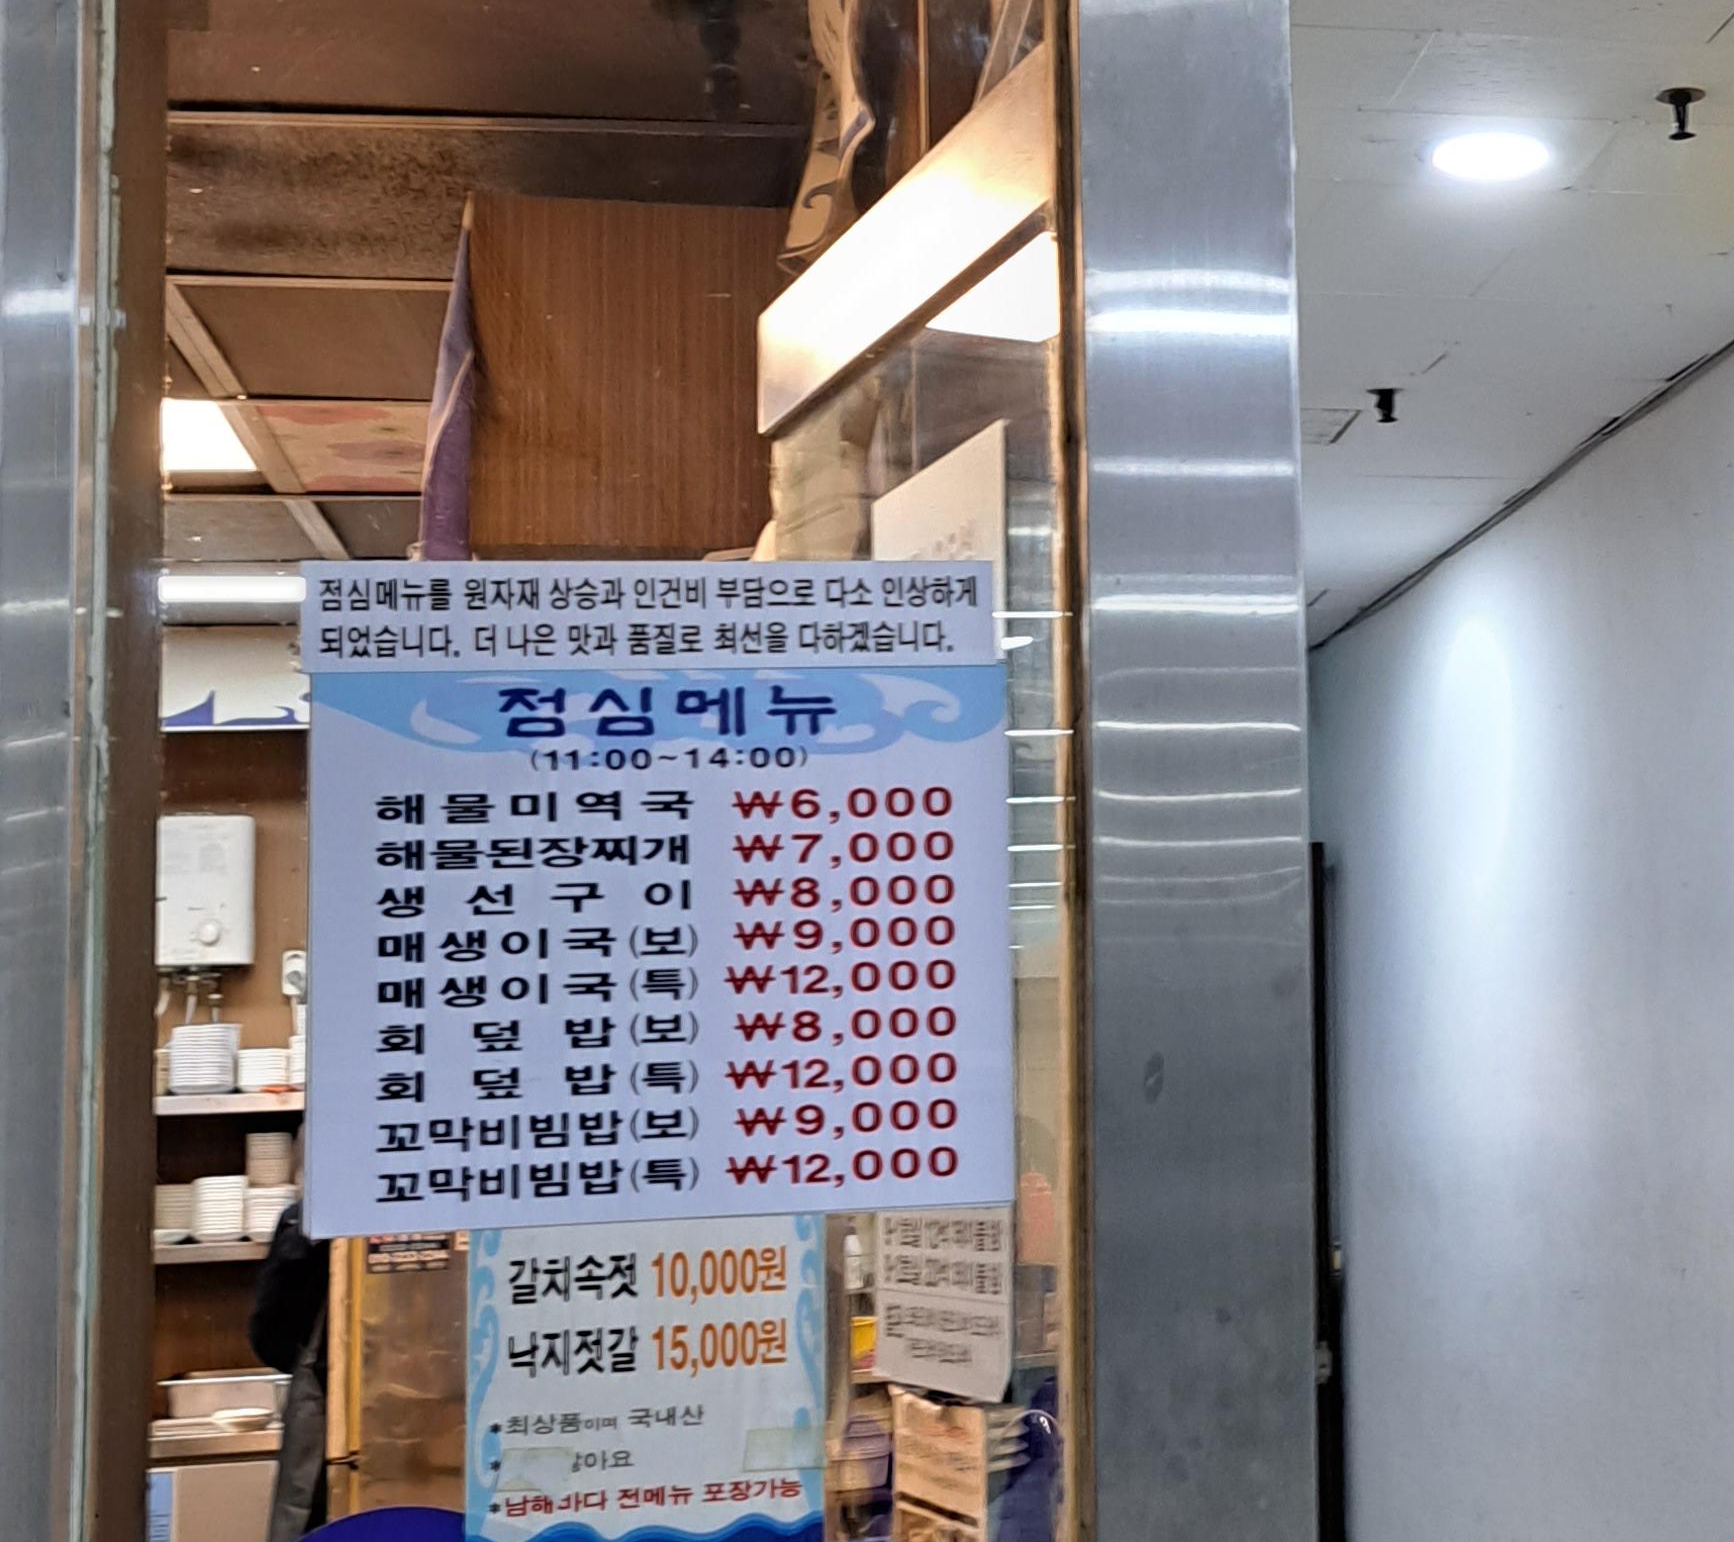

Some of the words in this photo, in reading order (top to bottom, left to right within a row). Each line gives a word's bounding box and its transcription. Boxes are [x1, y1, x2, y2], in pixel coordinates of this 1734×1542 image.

[319, 578, 452, 611] 점심메뉴를
[464, 577, 540, 610] 원자재
[550, 577, 624, 610] 상승과
[633, 577, 706, 609] 인건비
[715, 577, 817, 609] 부담으로
[825, 576, 873, 608] 다소
[882, 575, 977, 607] 인상하게
[320, 624, 460, 659] 되었습니다.
[474, 624, 496, 657] 더
[507, 623, 556, 656] 나은
[568, 623, 617, 656] 맛과
[627, 622, 704, 655] 품질로
[714, 621, 789, 654] 최선을
[799, 620, 954, 653] 다하겠습니다.
[497, 685, 838, 738] 점심메뉴
[529, 745, 809, 772] (11:00~14:00)
[375, 790, 694, 826] 해물미역국
[731, 786, 953, 824] ₩6,000
[375, 834, 690, 872] 해물된장찌개
[732, 830, 955, 870] ₩7,000
[732, 874, 956, 912] ₩8,000
[377, 923, 699, 964] 매생이국(보)
[733, 916, 956, 956] ₩9,000
[377, 966, 699, 1010] 매생이국(특)
[724, 959, 957, 999] ₩12,000
[735, 1007, 957, 1046] ₩8,000
[725, 1052, 958, 1095] ₩12,000
[376, 1106, 699, 1154] 꼬막비빔밥(보)
[734, 1099, 958, 1142] ₩9,000
[376, 1155, 699, 1204] 꼬막비빔밥(특)
[725, 1146, 959, 1190] ₩12,000
[508, 1254, 639, 1306] 갈치속젓
[651, 1245, 787, 1304] 10,000원
[508, 1326, 639, 1379] 낙지젓갈
[651, 1318, 787, 1377] 15,000원
[505, 1412, 618, 1436] 최상품이며
[628, 1404, 705, 1428] 국내산
[505, 1490, 608, 1518] 남해바다
[617, 1484, 694, 1509] 전메뉴
[701, 1478, 802, 1503] 포장가능
